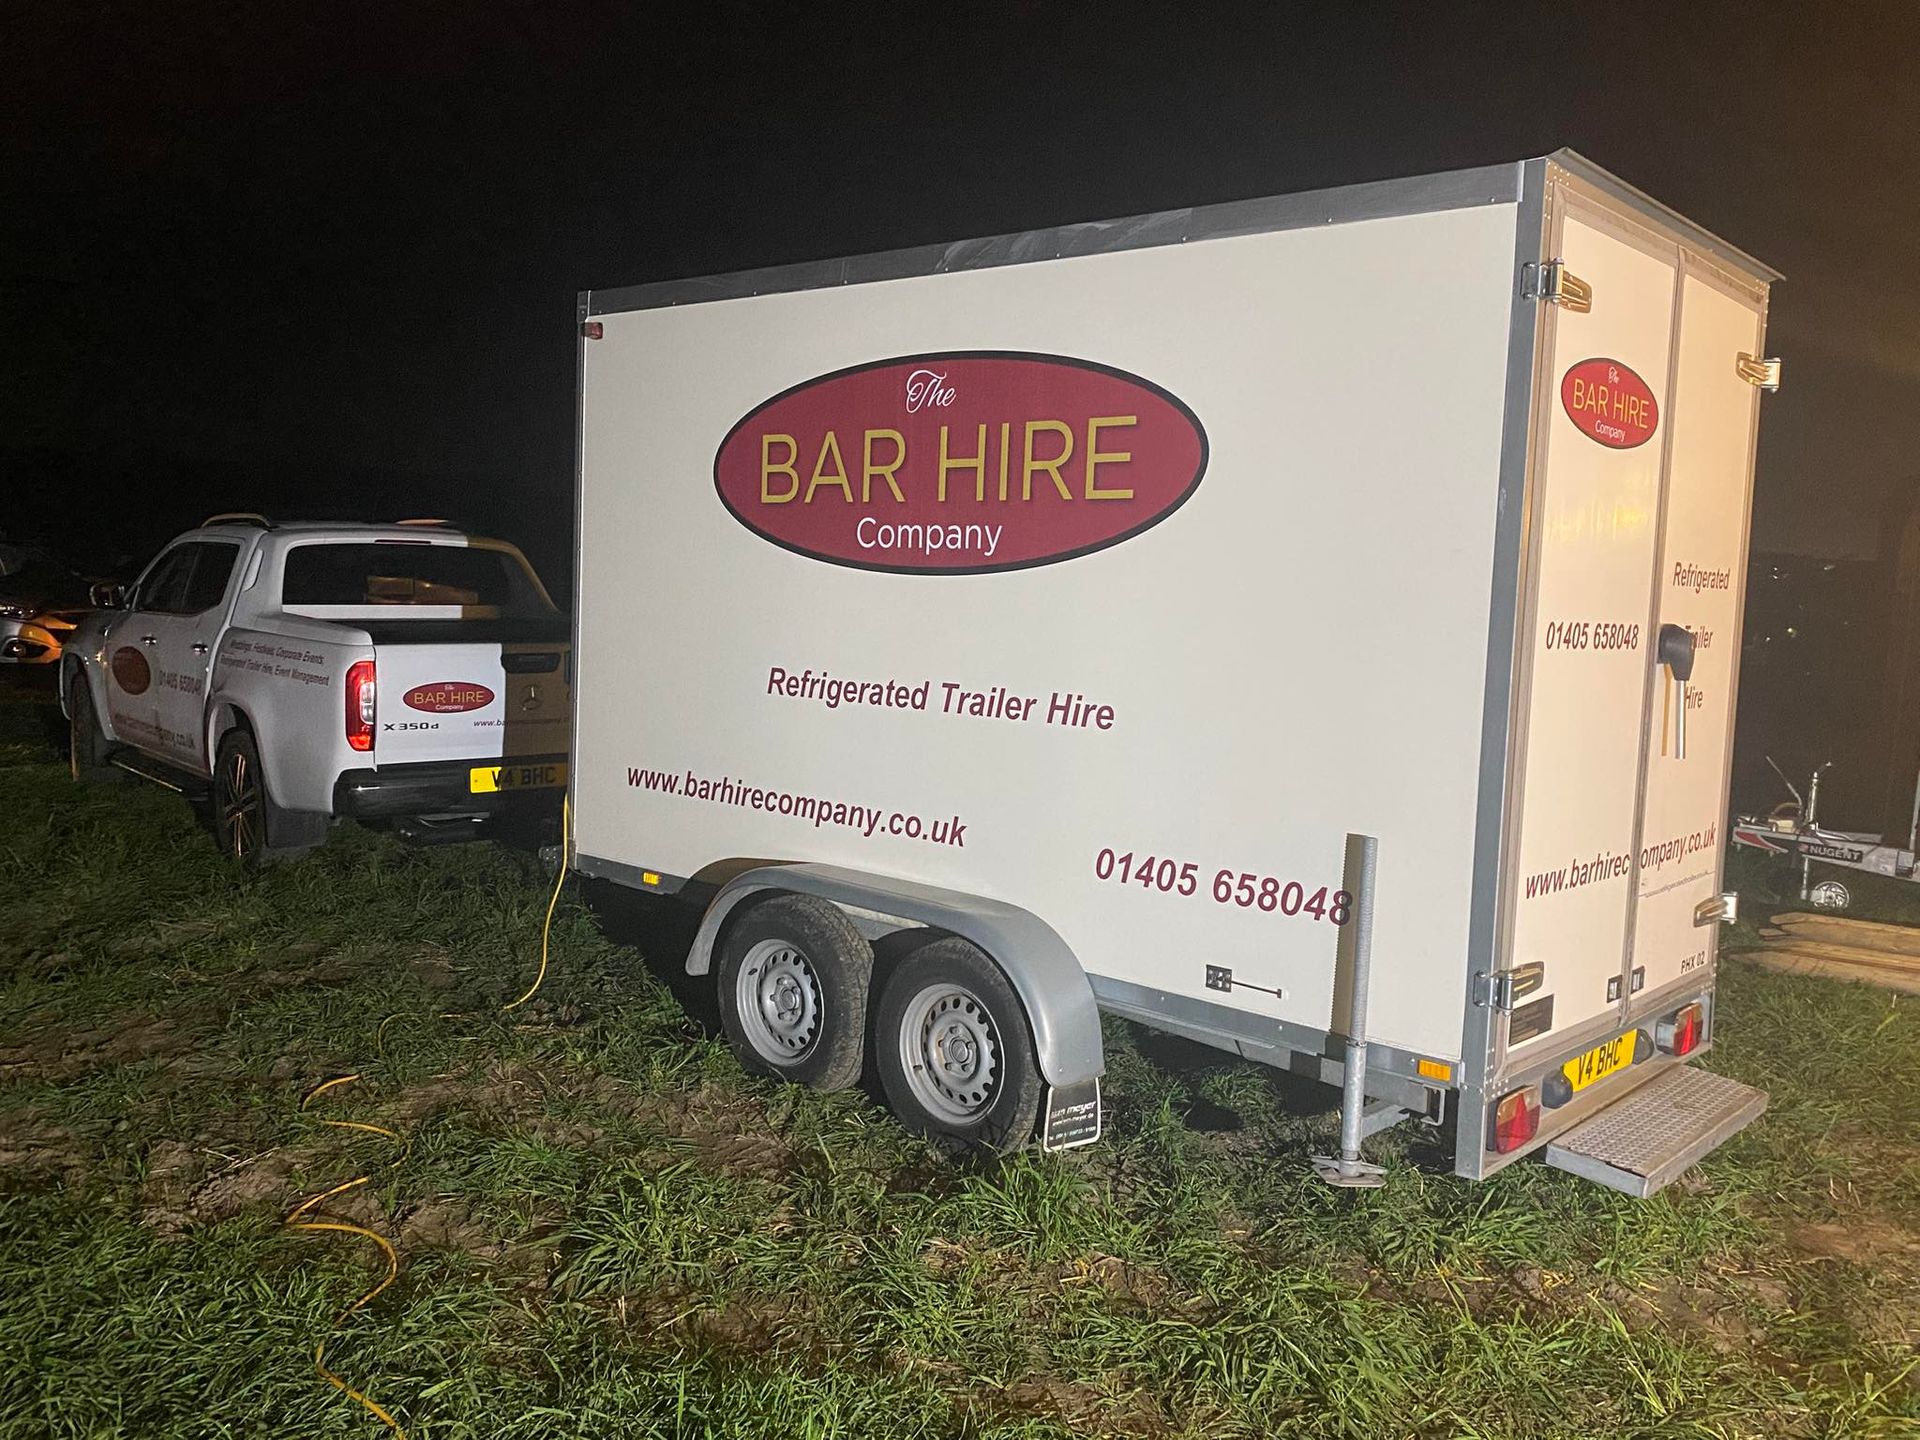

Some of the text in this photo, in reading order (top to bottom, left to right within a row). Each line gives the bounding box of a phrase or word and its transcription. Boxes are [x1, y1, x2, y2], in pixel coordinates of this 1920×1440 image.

[905, 369, 957, 414] The
[1573, 378, 1650, 429] BAR HIRE
[1595, 420, 1626, 442] Company
[760, 415, 1138, 504] BAR HIRE
[855, 517, 1003, 556] Company
[1673, 562, 1730, 594] Refrigerated
[1546, 621, 1639, 650] 01405 658048
[414, 691, 484, 704] BAR HIRE
[767, 667, 1115, 730] Refrigerated Trailer Hire
[384, 722, 439, 731] X 350d
[492, 767, 556, 788] V4 BHC
[626, 766, 968, 847] www.barhirecompany.co.uk
[1526, 822, 1716, 899] www.barhirecompany.co.uk
[1809, 845, 1861, 862] NUGENT
[1095, 848, 1354, 926] 01405 658048
[1578, 1037, 1623, 1085] V4 BHC
